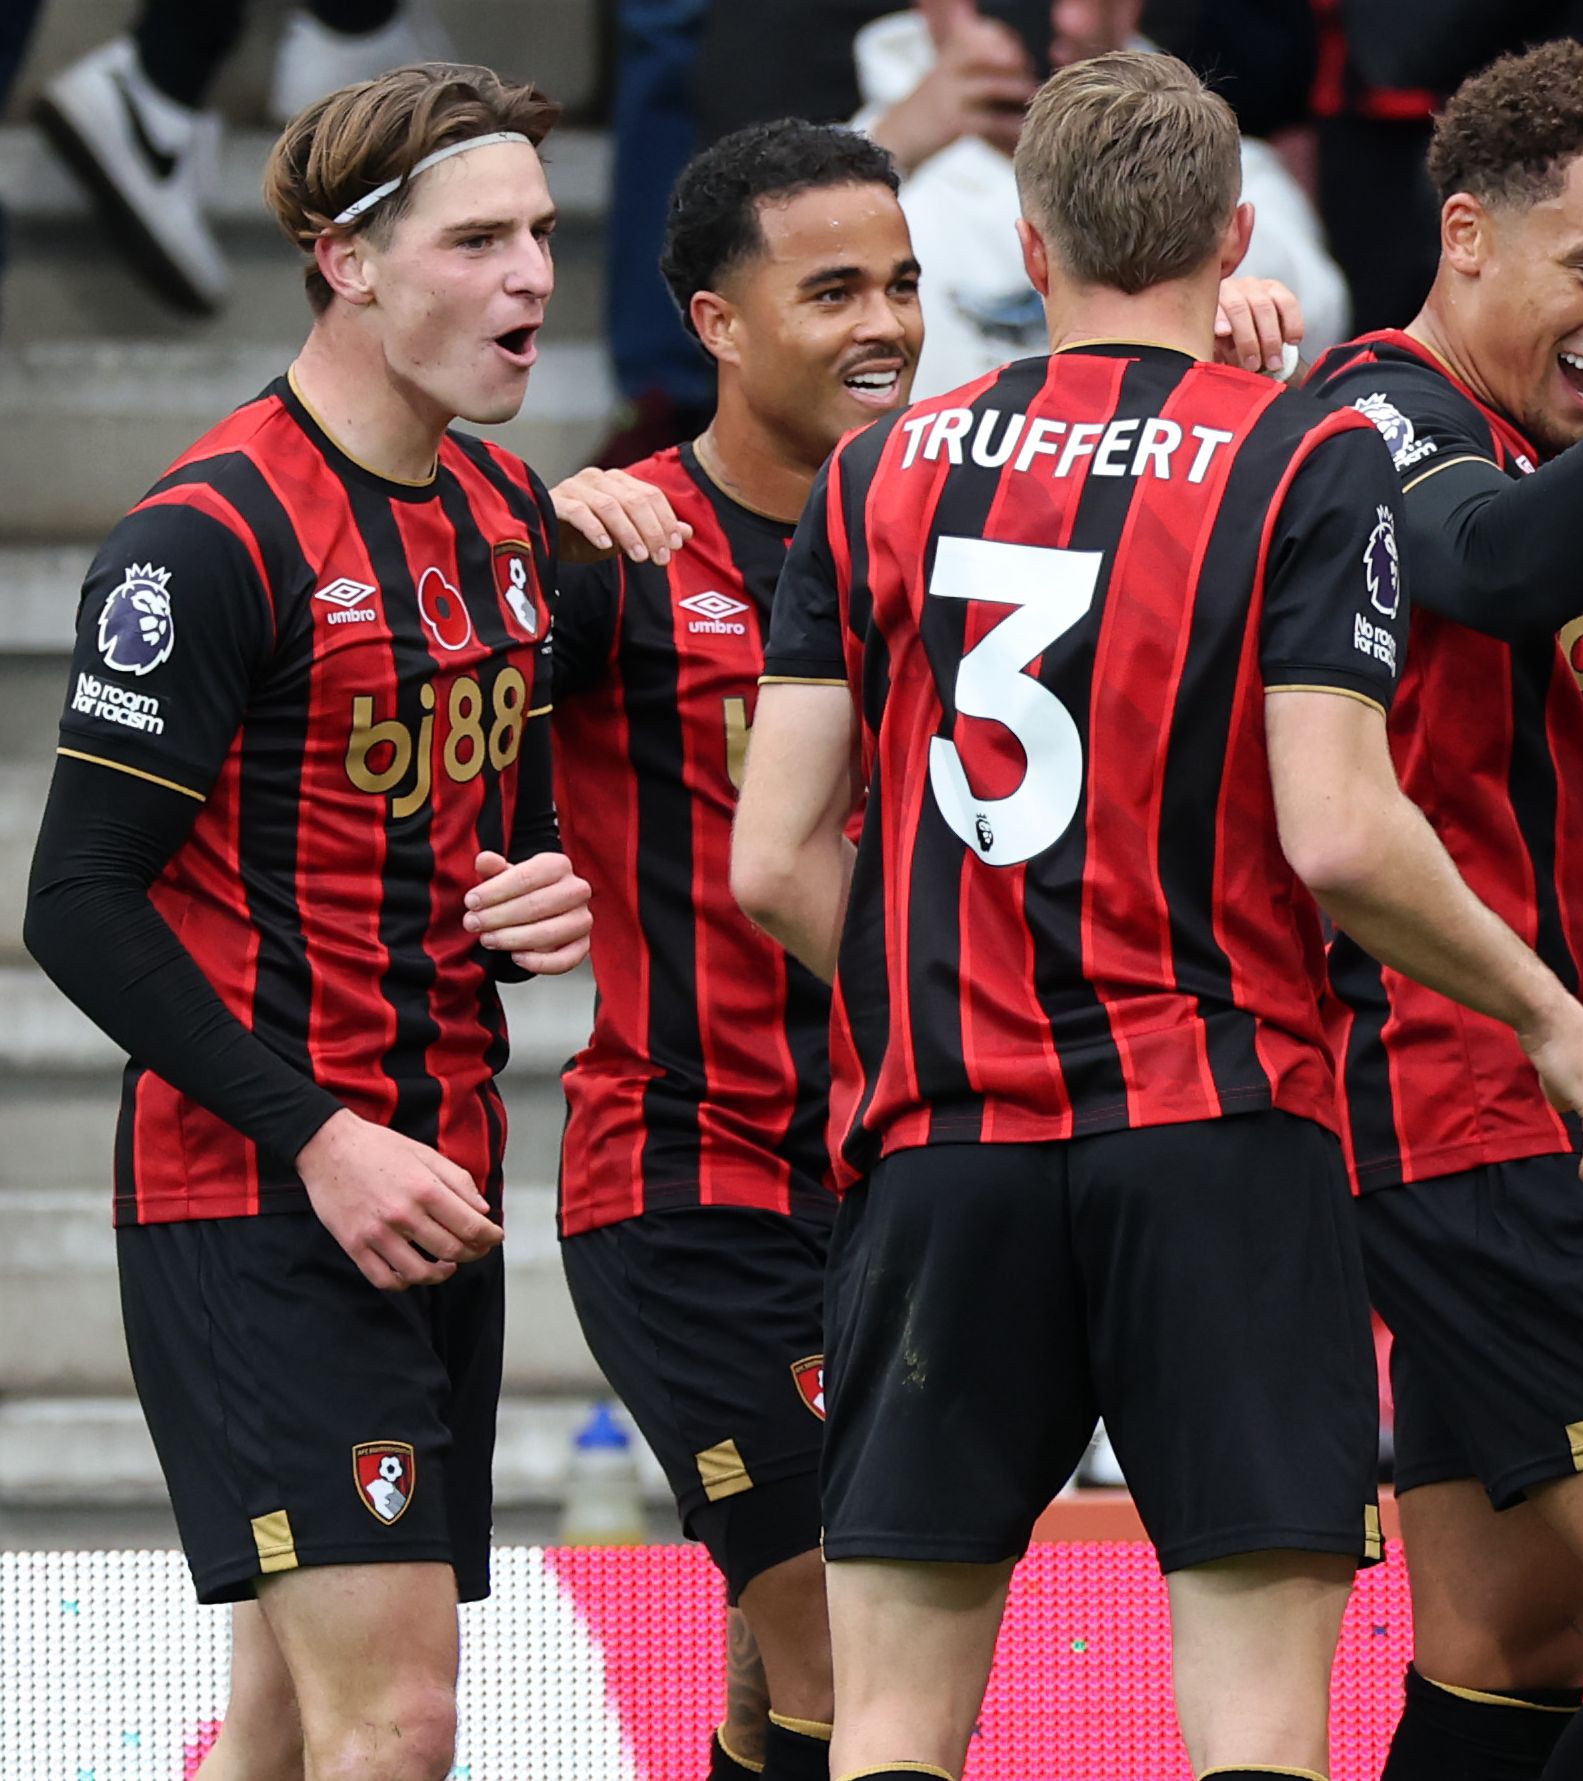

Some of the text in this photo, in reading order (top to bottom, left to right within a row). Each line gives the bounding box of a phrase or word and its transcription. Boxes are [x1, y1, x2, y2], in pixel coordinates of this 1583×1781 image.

[901, 408, 1233, 483] TRUFFERT
[327, 607, 376, 624] umbro
[688, 619, 745, 635] umbro
[1355, 612, 1374, 639] No
[71, 691, 165, 735] for racism
[76, 672, 158, 715] No room
[929, 536, 1104, 867] 3
[345, 667, 526, 818] bj88
